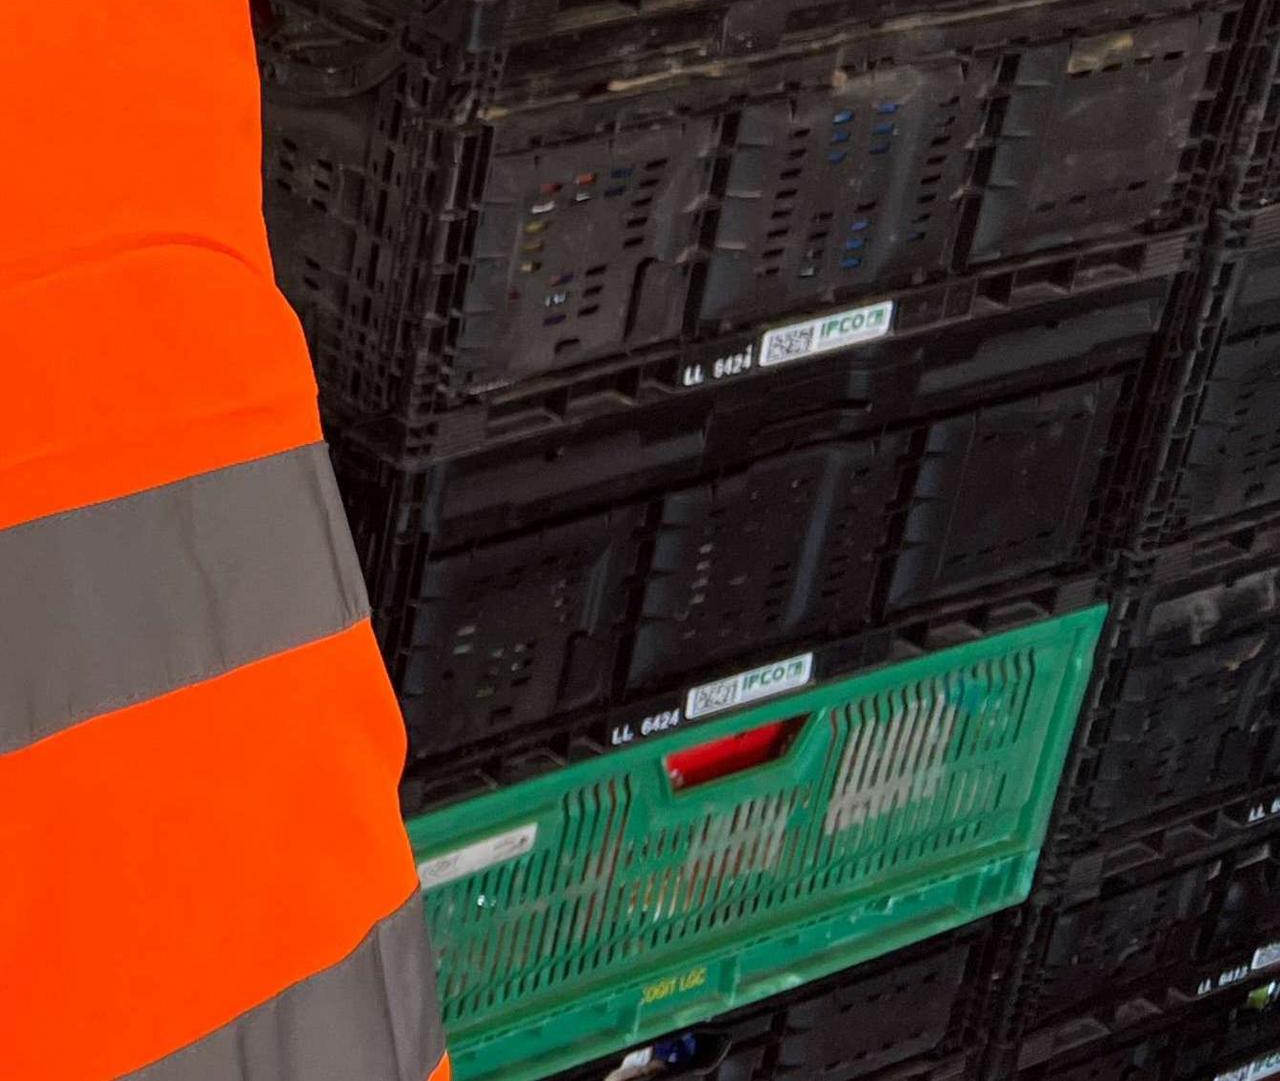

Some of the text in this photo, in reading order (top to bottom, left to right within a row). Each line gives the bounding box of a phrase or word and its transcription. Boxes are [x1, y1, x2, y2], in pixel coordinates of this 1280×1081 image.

[820, 314, 865, 338] IFCO
[684, 365, 704, 386] LL
[743, 668, 785, 691] IFCO
[612, 709, 680, 745] LL 6424
